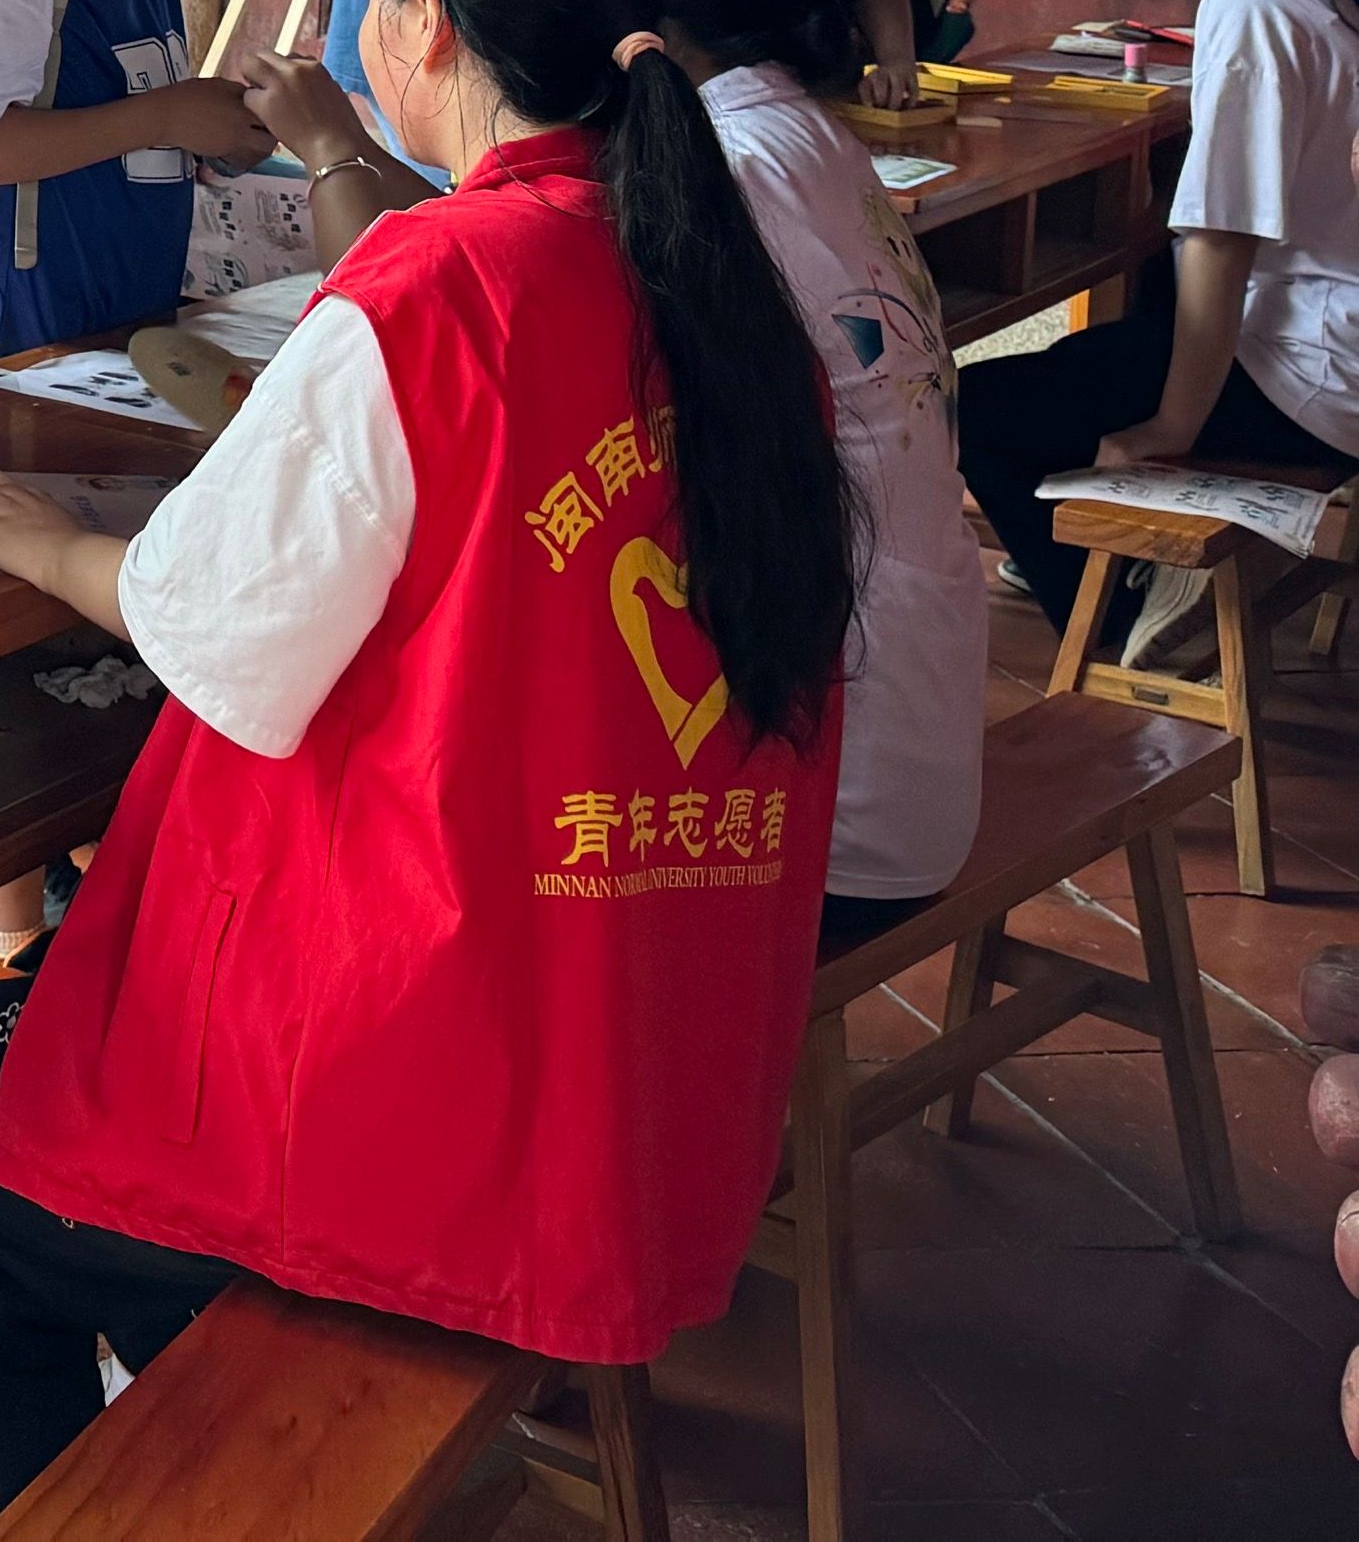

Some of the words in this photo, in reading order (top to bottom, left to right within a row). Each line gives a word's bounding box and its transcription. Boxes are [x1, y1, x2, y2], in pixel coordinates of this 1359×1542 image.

[554, 786, 787, 868] 青年志愿者
[534, 874, 612, 899] MINNAN
[709, 865, 746, 887] YOUTH
